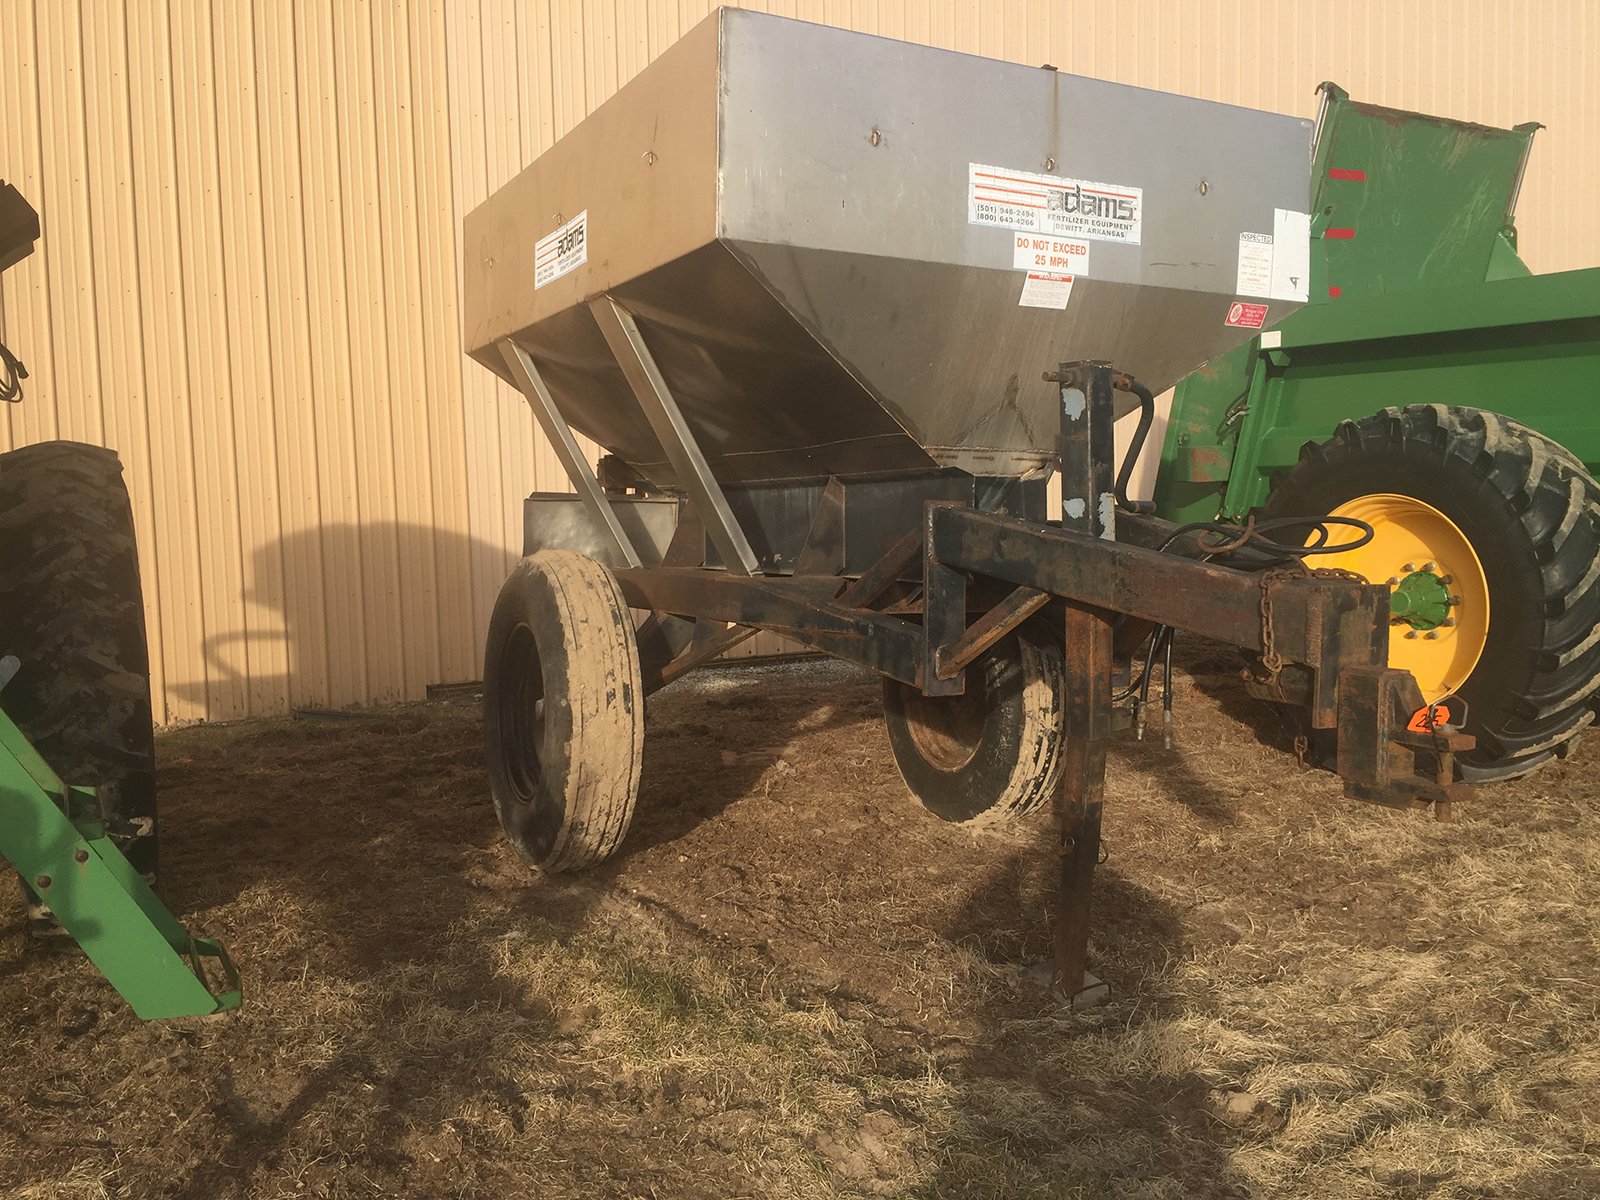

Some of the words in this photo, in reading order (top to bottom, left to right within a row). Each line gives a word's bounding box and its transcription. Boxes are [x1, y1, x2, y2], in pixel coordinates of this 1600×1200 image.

[977, 204, 997, 214] (501)
[1000, 207, 1034, 218] 946-2494
[977, 213, 997, 222] (800)
[1000, 216, 1034, 226] 643-4266
[1048, 213, 1089, 225] FERTILIZER
[1092, 220, 1133, 231] EQUIPMENT
[1087, 228, 1125, 238] ARKANSAS
[1241, 233, 1272, 243] INSPECTED
[557, 224, 584, 258] adams
[1017, 237, 1029, 249] DO
[1033, 240, 1050, 251] NOT
[1053, 242, 1087, 256] EXCEED
[1035, 254, 1046, 265] 25
[1050, 256, 1069, 269] MPH
